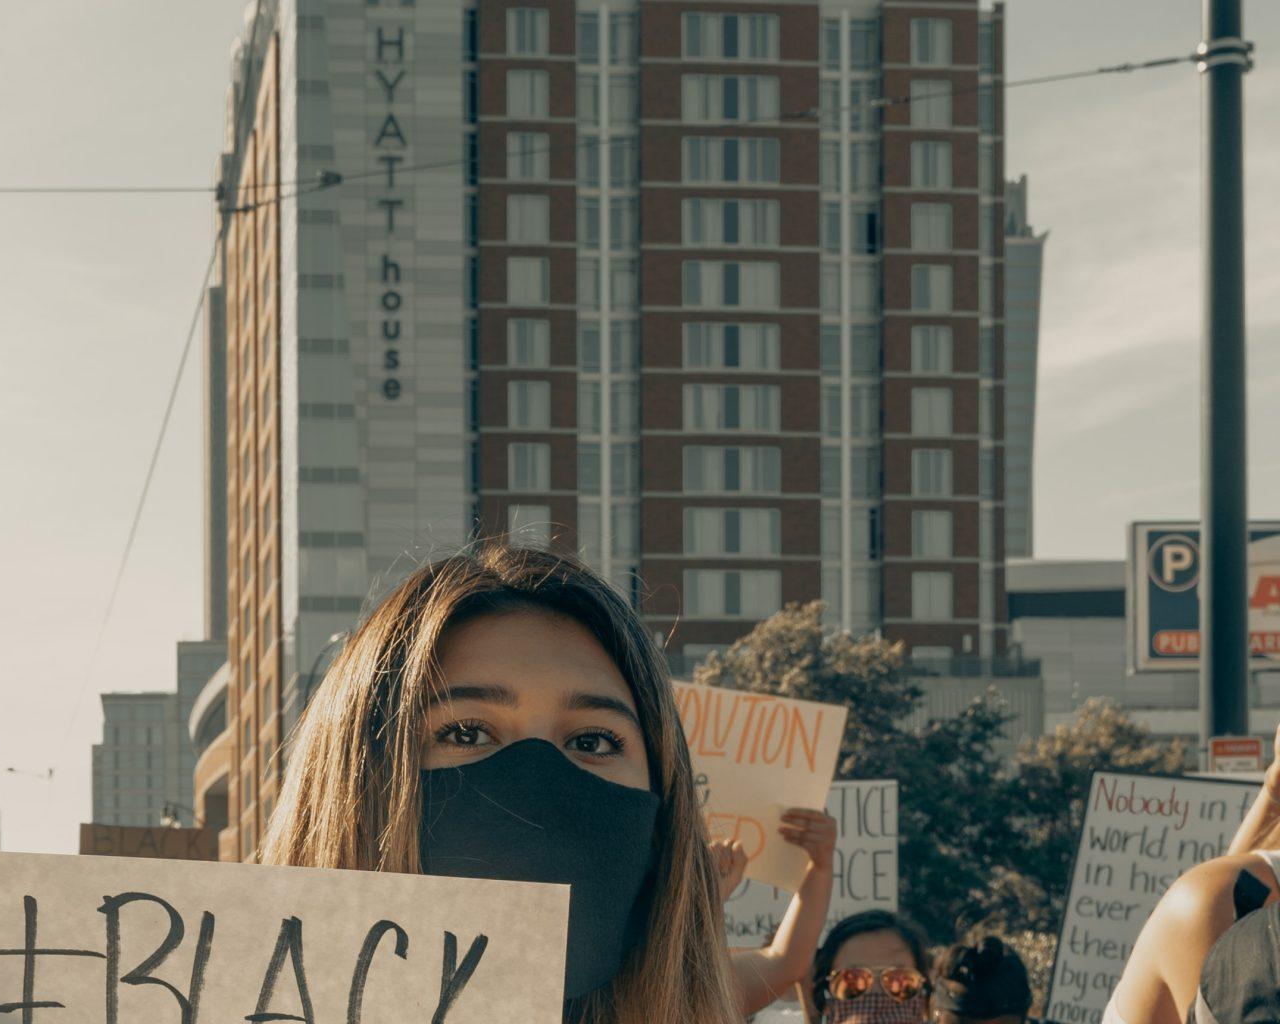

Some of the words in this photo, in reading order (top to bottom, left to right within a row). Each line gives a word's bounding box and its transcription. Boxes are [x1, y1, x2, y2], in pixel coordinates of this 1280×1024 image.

[374, 26, 407, 232] HYATT
[380, 254, 402, 400] house
[1162, 544, 1194, 584] P
[1160, 633, 1200, 652] PUB
[675, 686, 823, 774] OLUTION
[826, 785, 898, 838] TICE
[1094, 776, 1189, 831] Nobody
[1200, 797, 1227, 822] in
[92, 826, 205, 859] BLACK
[1178, 832, 1225, 862] no
[831, 847, 894, 902] ACE
[1085, 862, 1114, 888] in
[1129, 862, 1183, 894] his
[1075, 895, 1141, 922] ever
[1070, 925, 1130, 961] the
[1060, 960, 1089, 1002] by
[1092, 970, 1121, 1000] ap
[1052, 1000, 1103, 1024] mora
